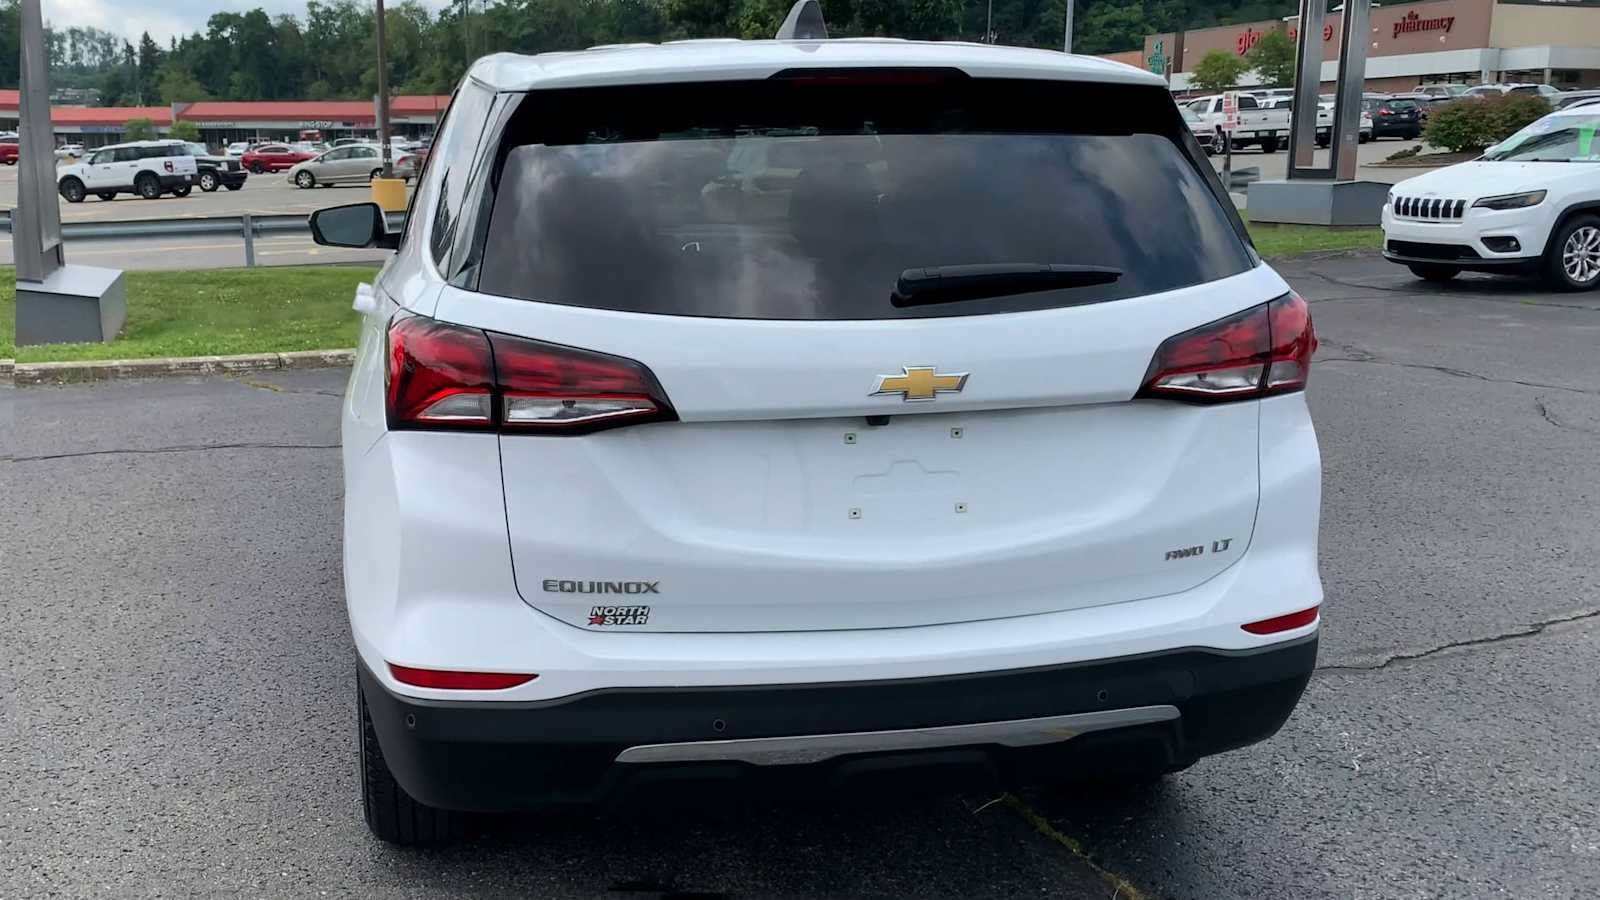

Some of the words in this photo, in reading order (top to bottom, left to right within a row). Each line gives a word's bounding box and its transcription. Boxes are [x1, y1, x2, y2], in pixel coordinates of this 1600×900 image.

[1393, 16, 1455, 39] pharmacy
[1165, 546, 1204, 561] AWD
[1212, 538, 1233, 552] LT
[543, 579, 660, 594] EQUINOX
[590, 606, 650, 616] NORTH
[603, 615, 649, 625] STAR
